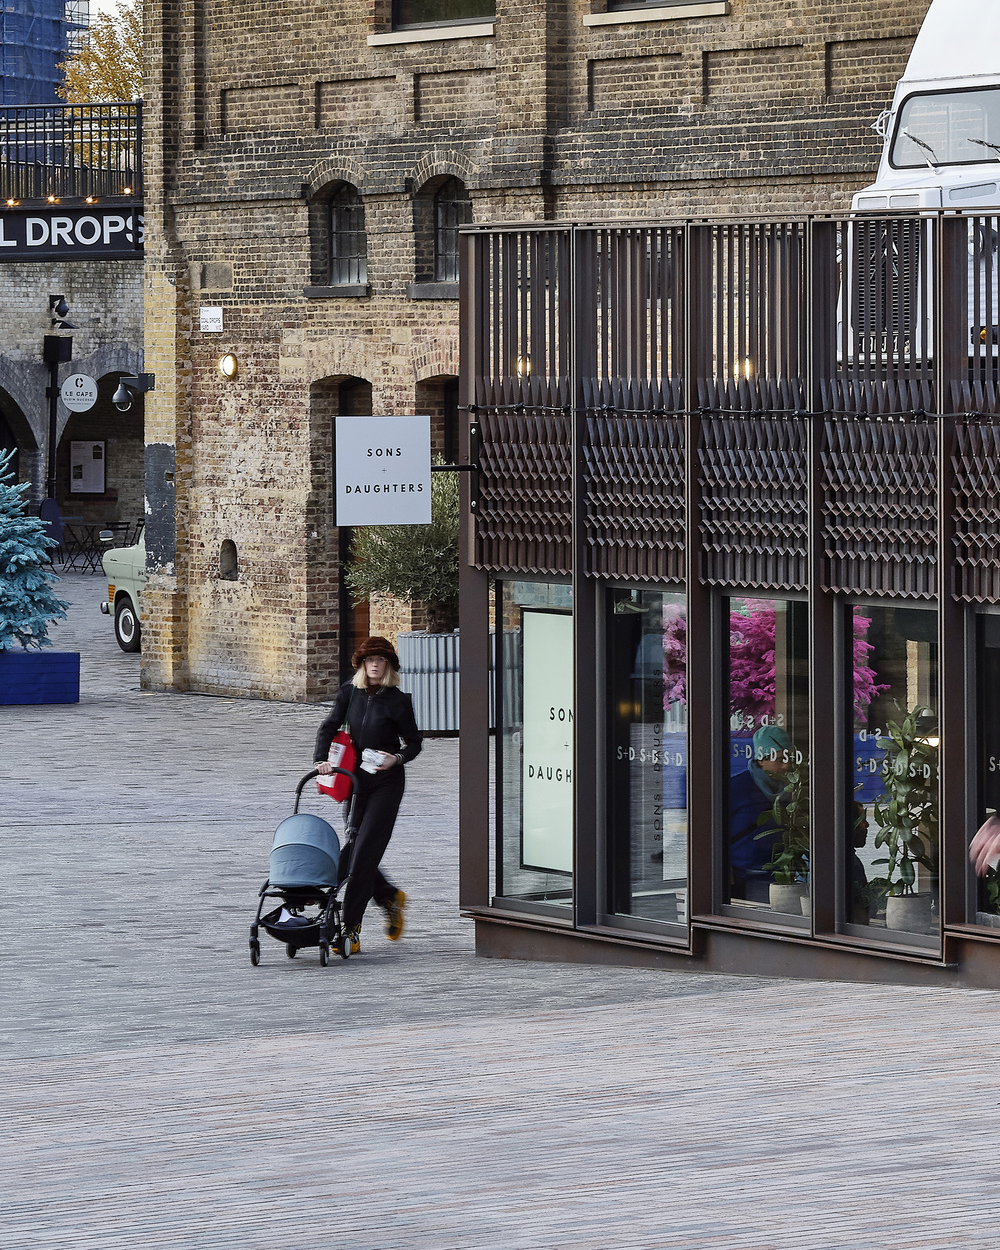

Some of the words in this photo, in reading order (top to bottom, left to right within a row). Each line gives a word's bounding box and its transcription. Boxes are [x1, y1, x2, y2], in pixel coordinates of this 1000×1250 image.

[26, 215, 144, 246] DROPS
[367, 448, 402, 457] SONS
[346, 484, 423, 494] DAUGHTERS
[617, 746, 636, 760] S+D
[664, 751, 682, 766] S+D
[734, 744, 752, 758] S+D
[758, 746, 777, 762] S+D
[783, 749, 803, 764] S+D
[856, 757, 877, 772] S+D
[882, 760, 903, 776] S+D
[910, 762, 930, 778] S+D
